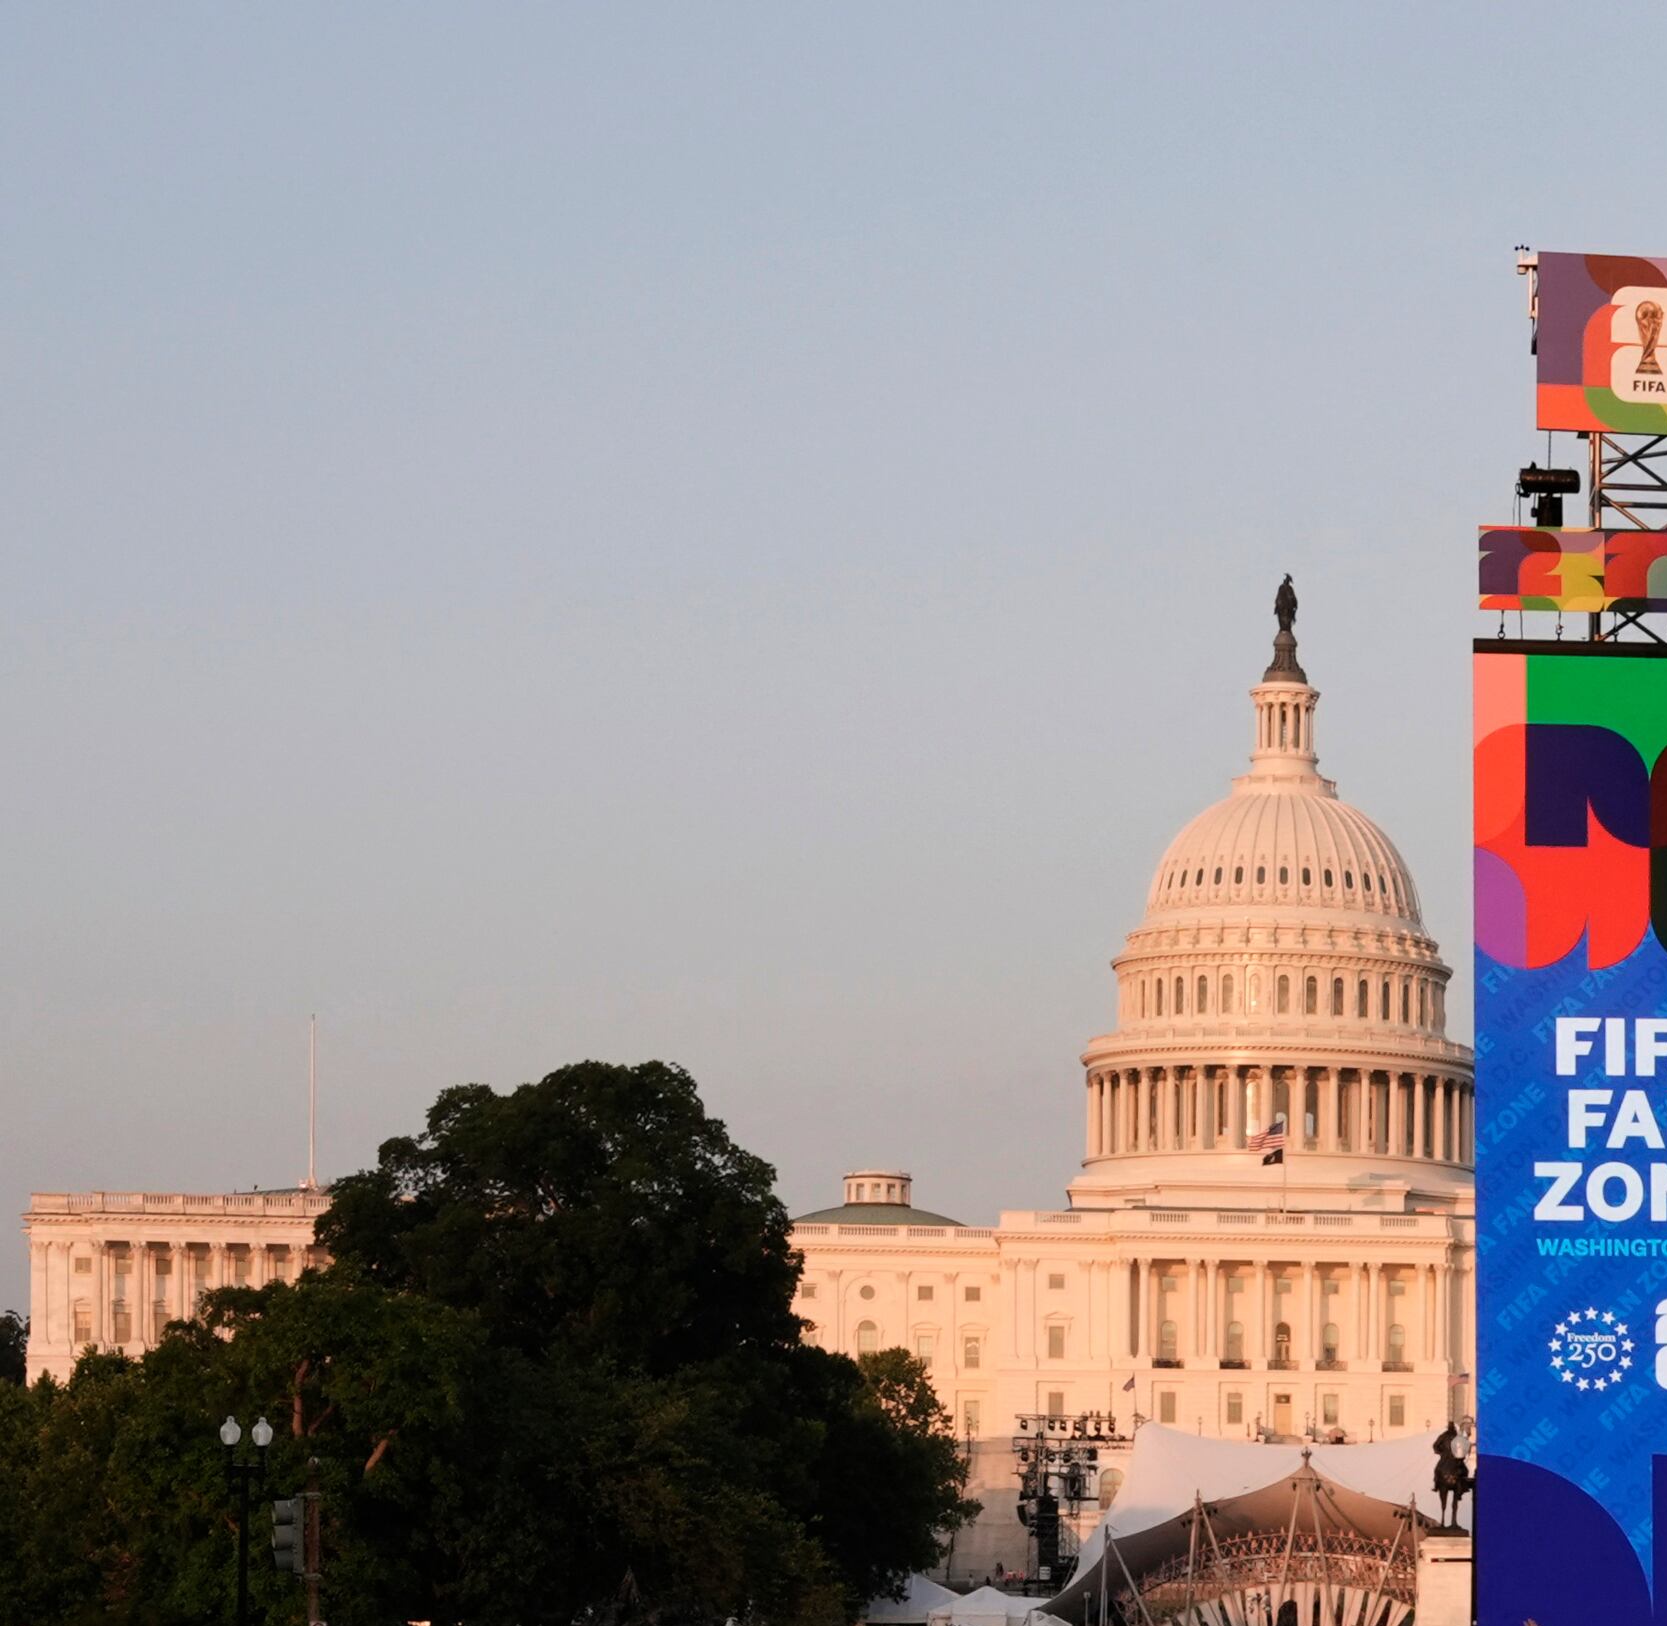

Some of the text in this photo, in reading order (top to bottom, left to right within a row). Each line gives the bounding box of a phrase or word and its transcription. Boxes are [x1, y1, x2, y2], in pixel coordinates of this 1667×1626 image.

[1633, 380, 1665, 392] FIFA
[1483, 1082, 1546, 1145] ZONE
[1497, 1281, 1549, 1332] FIFA
[1567, 1332, 1616, 1342] Freedom
[1567, 1343, 1616, 1368] 250
[1598, 1381, 1651, 1432] FIFA
